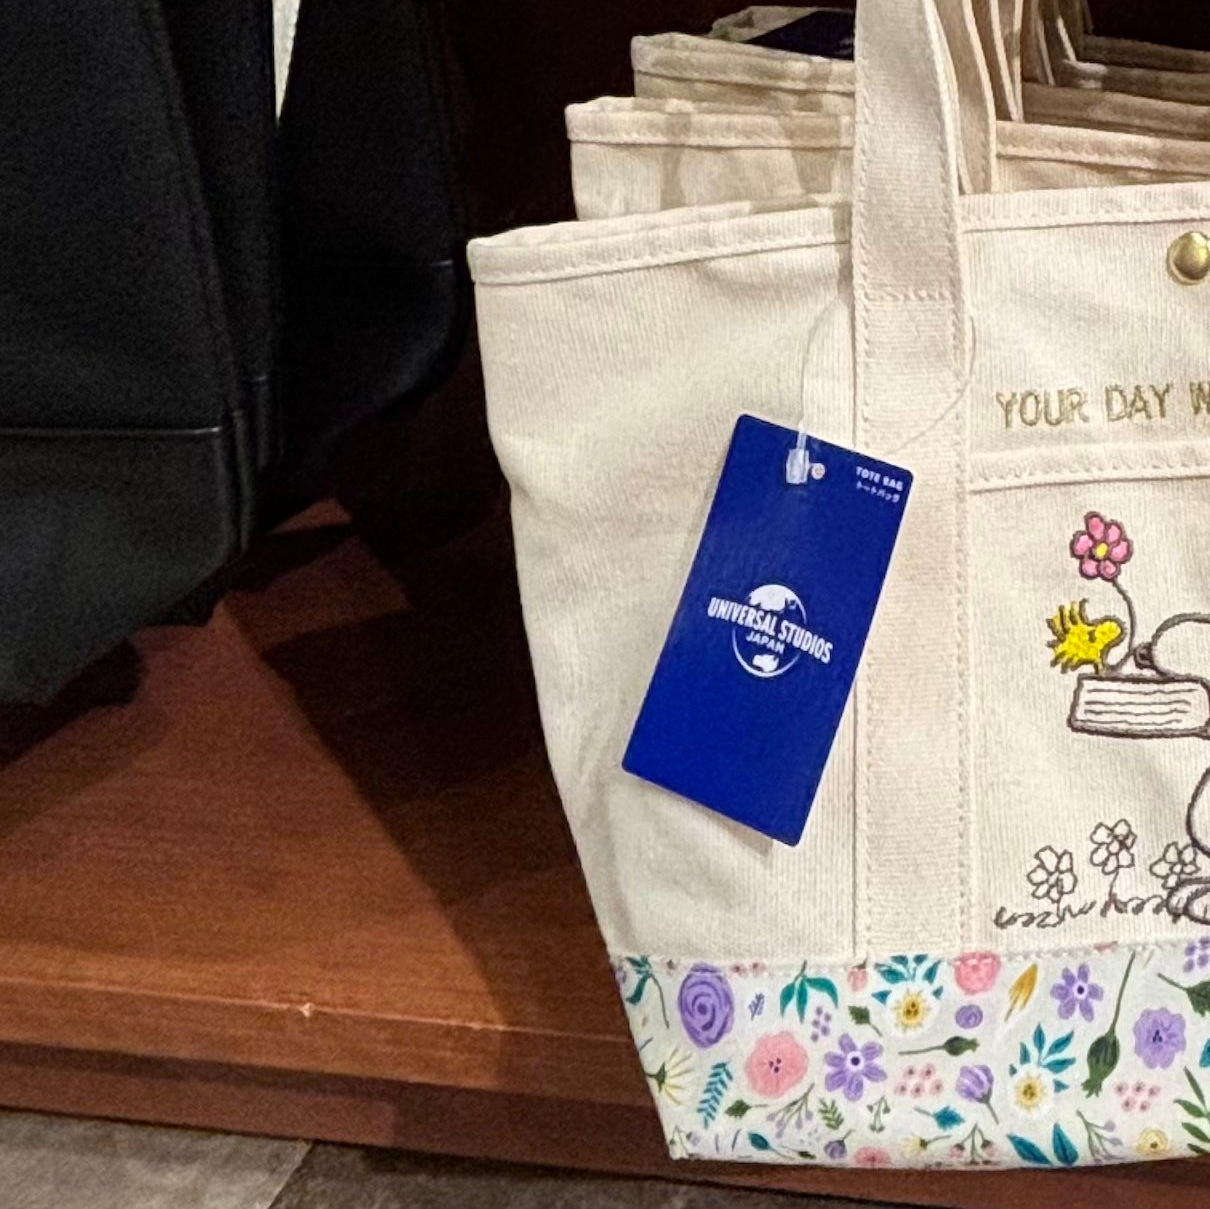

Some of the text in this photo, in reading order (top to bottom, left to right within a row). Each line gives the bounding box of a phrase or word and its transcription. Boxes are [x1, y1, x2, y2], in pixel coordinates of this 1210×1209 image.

[996, 387, 1090, 428] YOUR
[1105, 381, 1174, 422] DAY
[856, 466, 903, 492] TOTE BAG
[707, 597, 834, 664] UNIVERSAL STUDIOS
[746, 630, 786, 654] JAPAN
